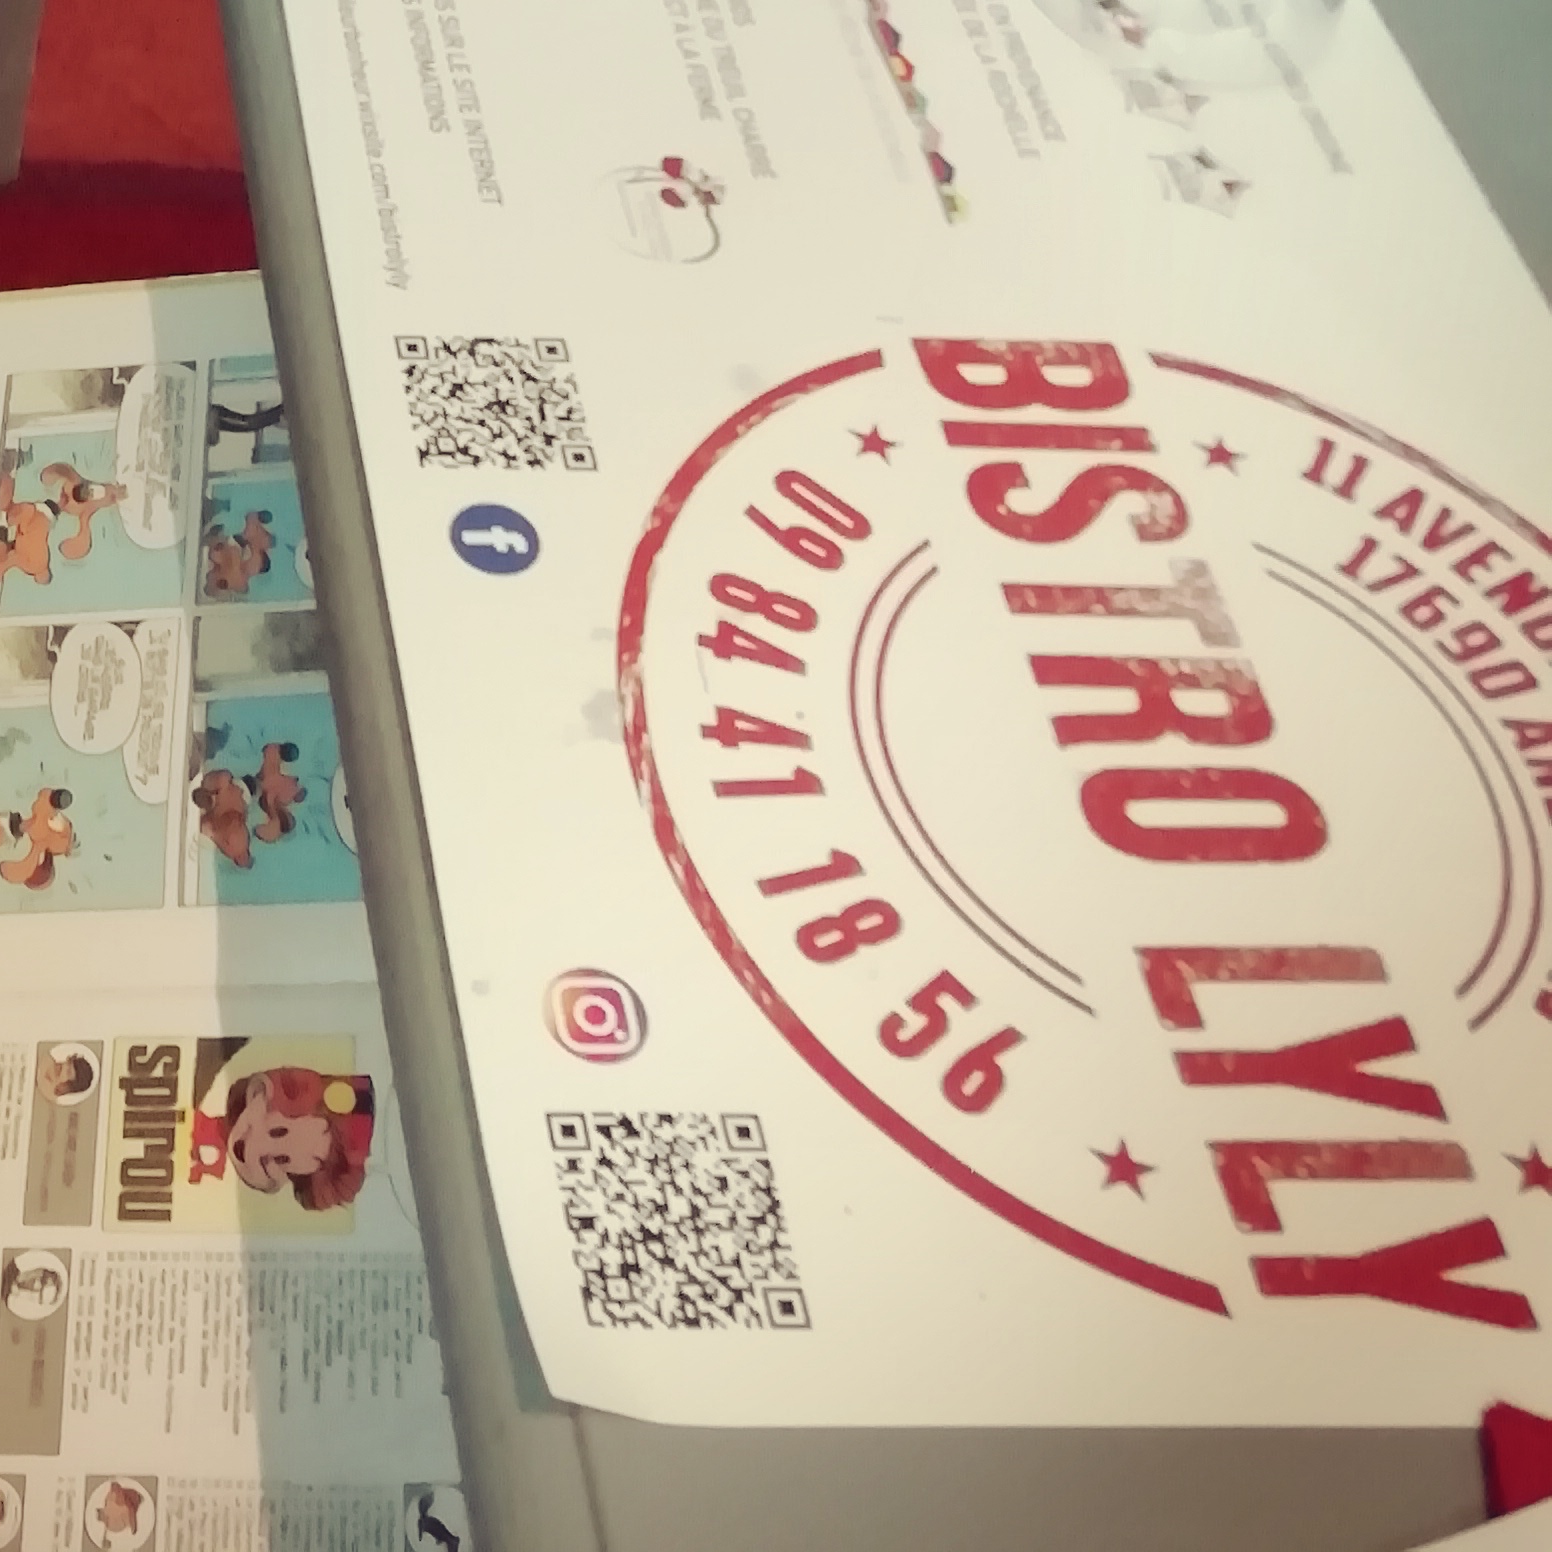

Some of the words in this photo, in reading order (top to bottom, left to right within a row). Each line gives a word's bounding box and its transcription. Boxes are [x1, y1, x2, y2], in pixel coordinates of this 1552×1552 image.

[463, 119, 505, 206] INTERNET
[743, 469, 872, 572] 09
[1302, 437, 1370, 502] 11
[1374, 485, 1552, 667] AVENU
[696, 572, 818, 676] 84
[1338, 534, 1538, 701] 17690
[699, 705, 825, 799] 41
[912, 336, 1329, 866] BISTRO
[1134, 943, 1538, 1333] LYLY
[757, 848, 902, 965] 18
[877, 968, 1025, 1116] 56
[118, 1044, 186, 1223] spirou
